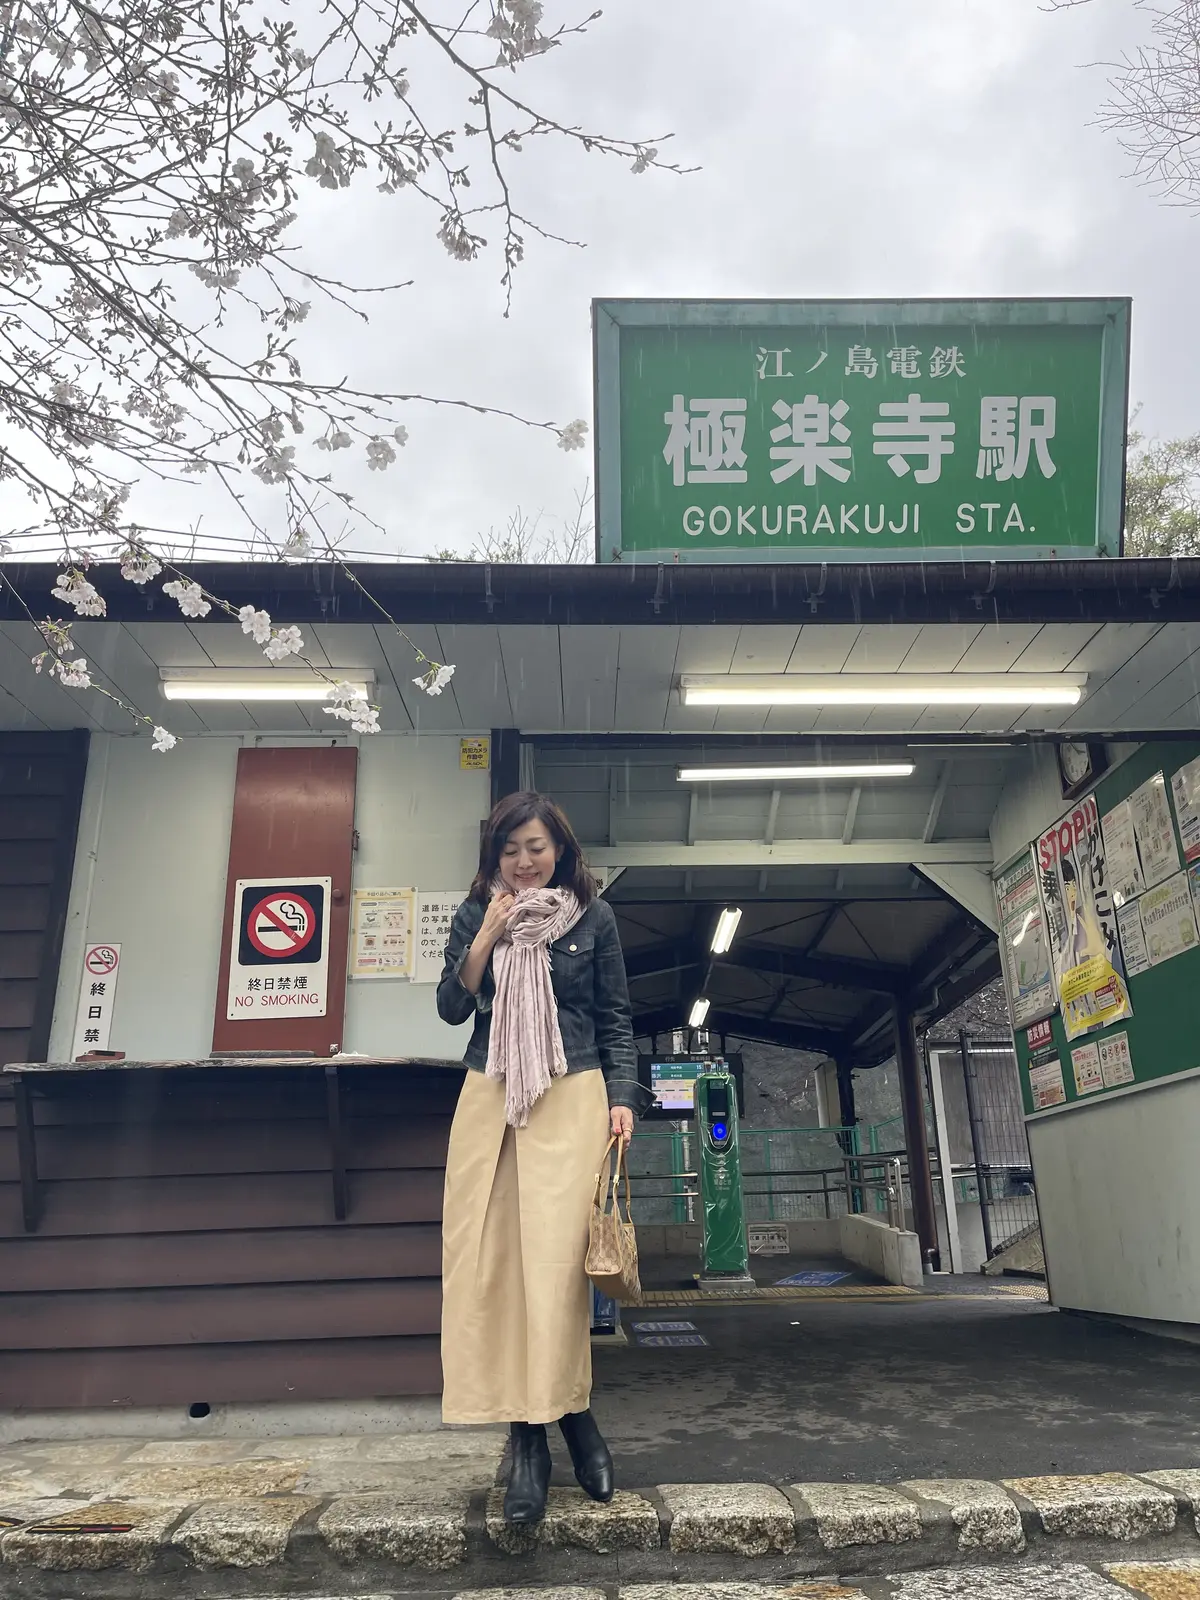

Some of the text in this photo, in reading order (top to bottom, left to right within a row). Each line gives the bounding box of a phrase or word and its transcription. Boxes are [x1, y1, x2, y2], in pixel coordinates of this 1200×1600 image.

[756, 345, 967, 380] 江ノ島電鉄
[663, 394, 1057, 486] 極楽寺駅
[682, 502, 1037, 537] GOKURAKUJI STA.
[1040, 799, 1097, 871] STOP!!
[234, 993, 319, 1008] NO SMOKING
[247, 976, 308, 992] 終日禁煙
